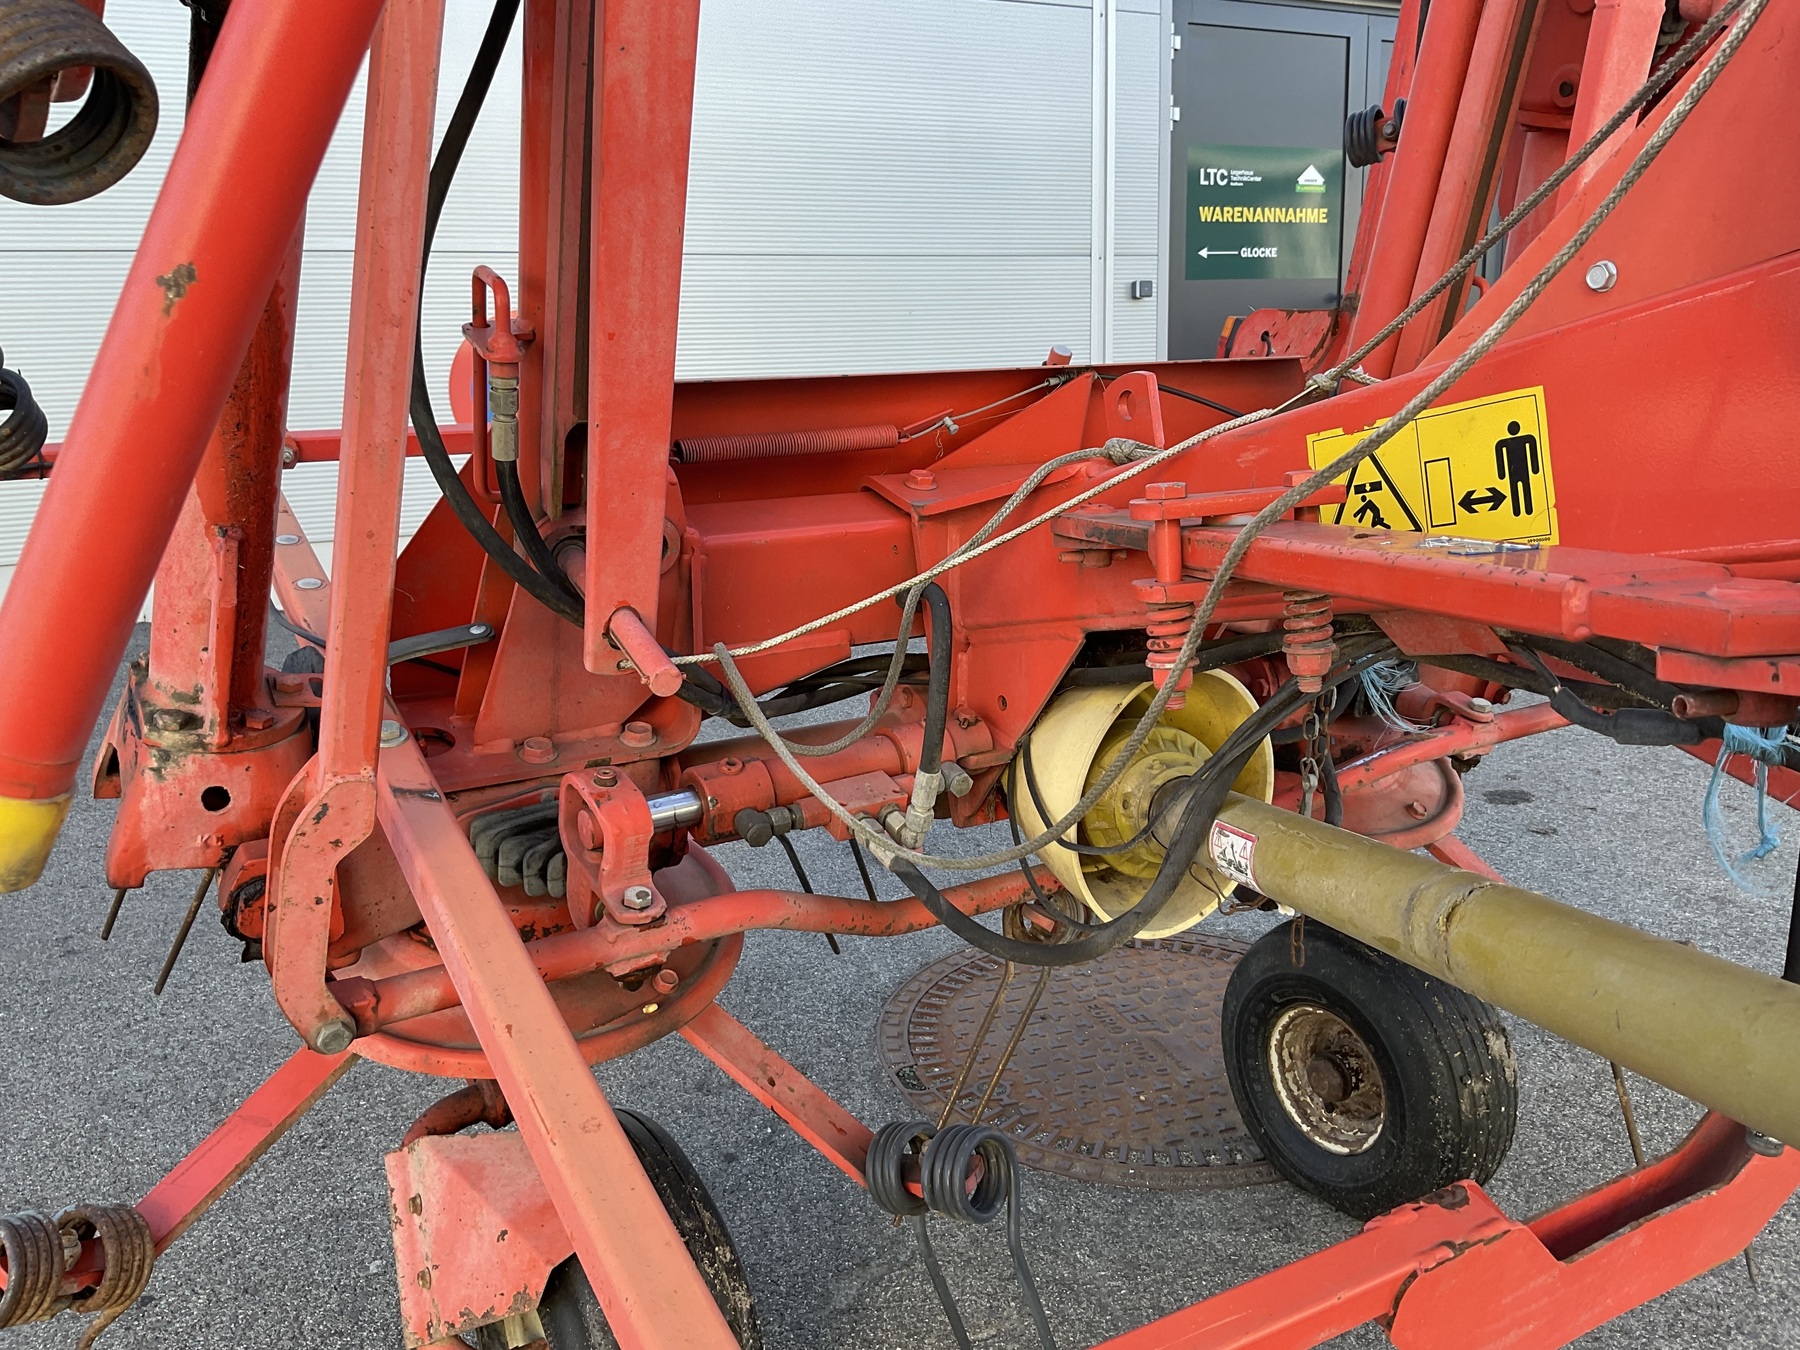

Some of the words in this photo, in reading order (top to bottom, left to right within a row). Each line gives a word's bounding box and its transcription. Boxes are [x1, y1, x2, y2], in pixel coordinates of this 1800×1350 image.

[1200, 168, 1228, 186] LTC
[1199, 206, 1328, 223] WARENANNAHME
[1240, 247, 1278, 258] GLOCKE
